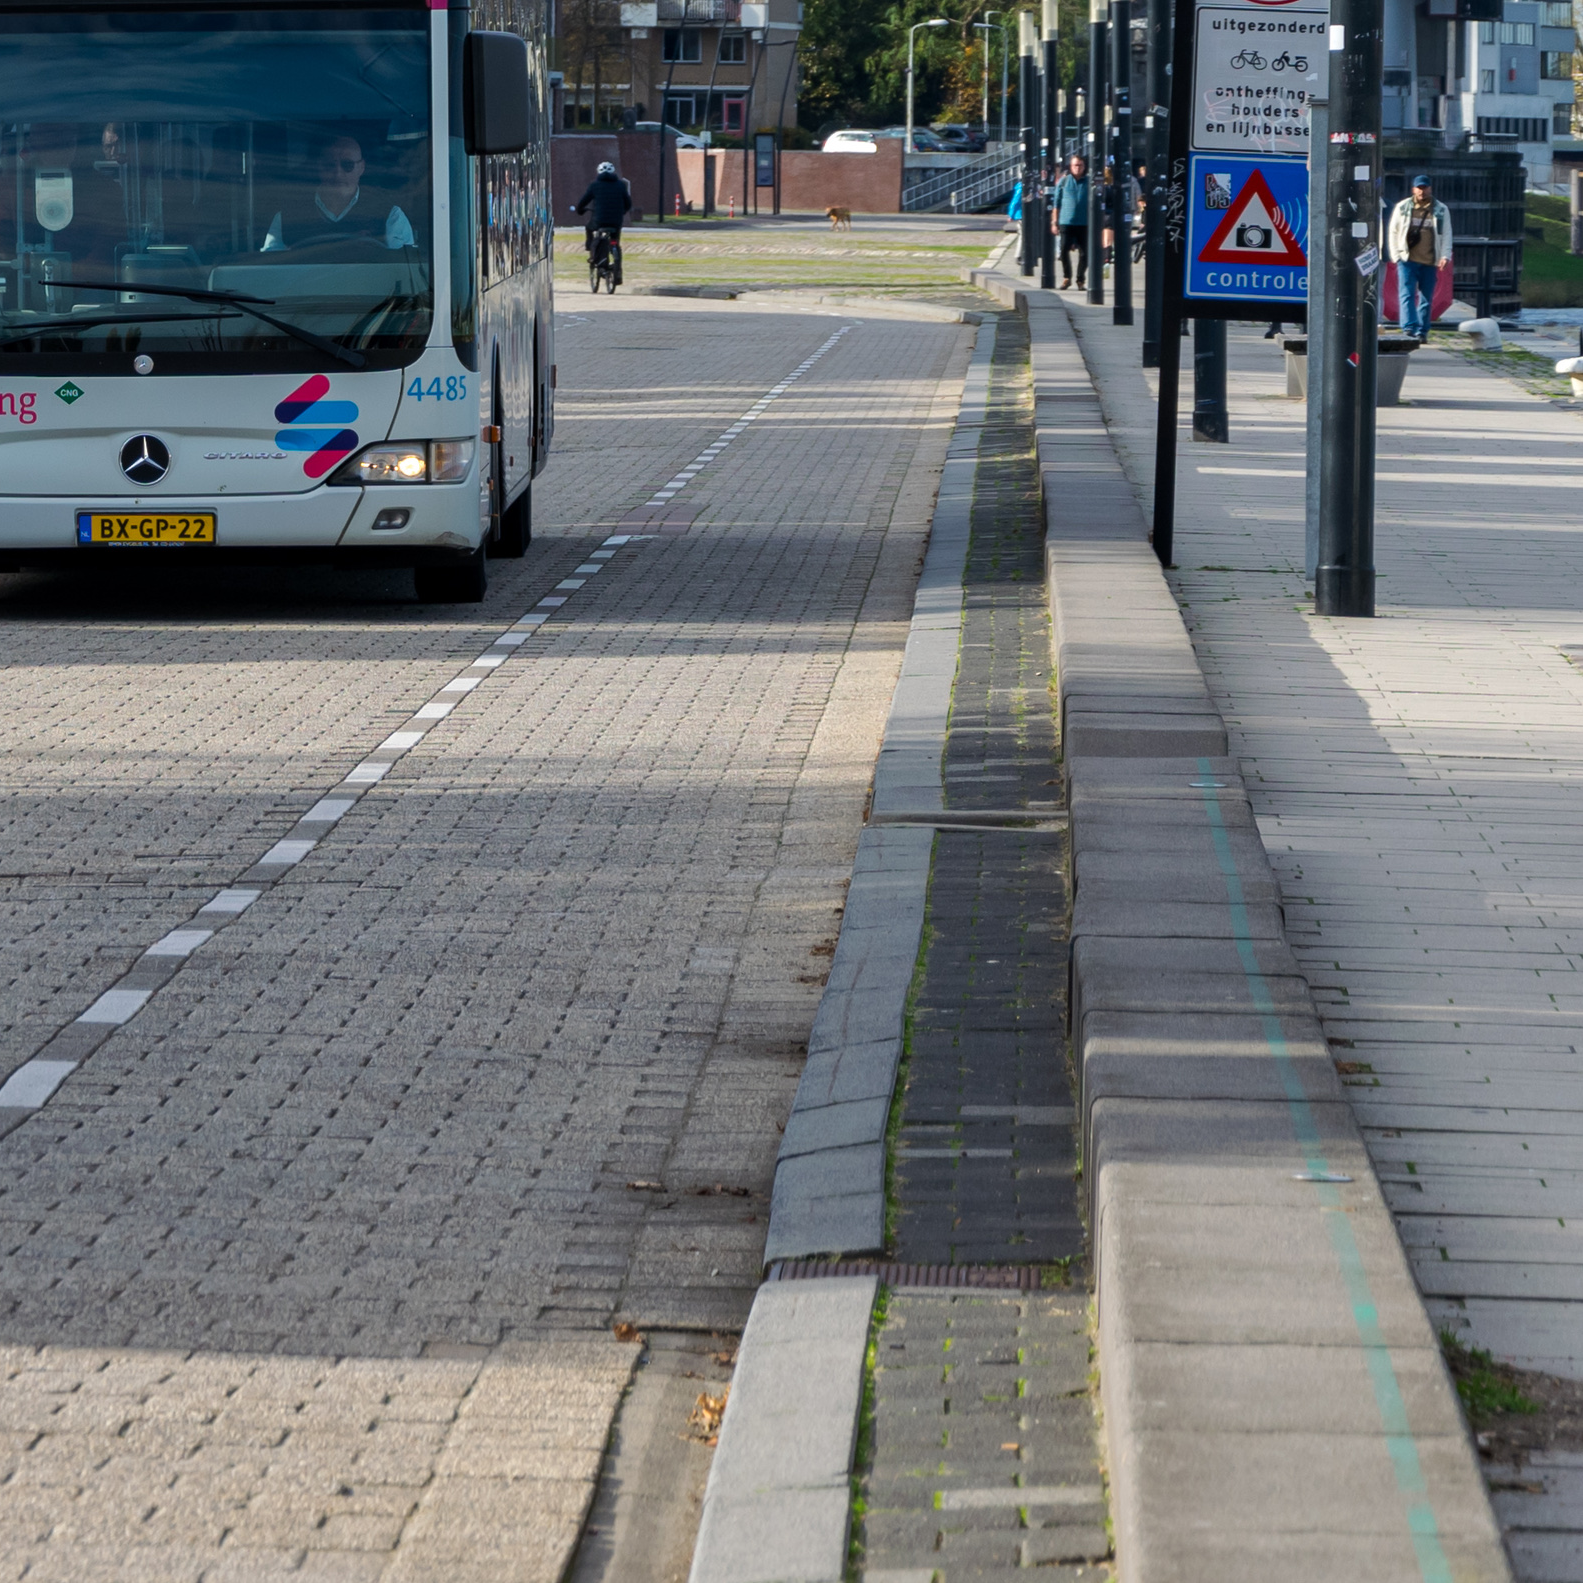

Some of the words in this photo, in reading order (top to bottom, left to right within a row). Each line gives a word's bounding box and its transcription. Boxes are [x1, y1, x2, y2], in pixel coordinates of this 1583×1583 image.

[1212, 18, 1326, 34] uitgezonderd
[1231, 104, 1300, 118] houders
[1206, 123, 1225, 133] en
[1232, 121, 1309, 137] lijnbusse
[1206, 271, 1309, 290] controle
[60, 389, 79, 397] CNG
[406, 375, 467, 401] 4485
[203, 451, 287, 460] CITARO
[100, 518, 207, 539] BX-GP-22
